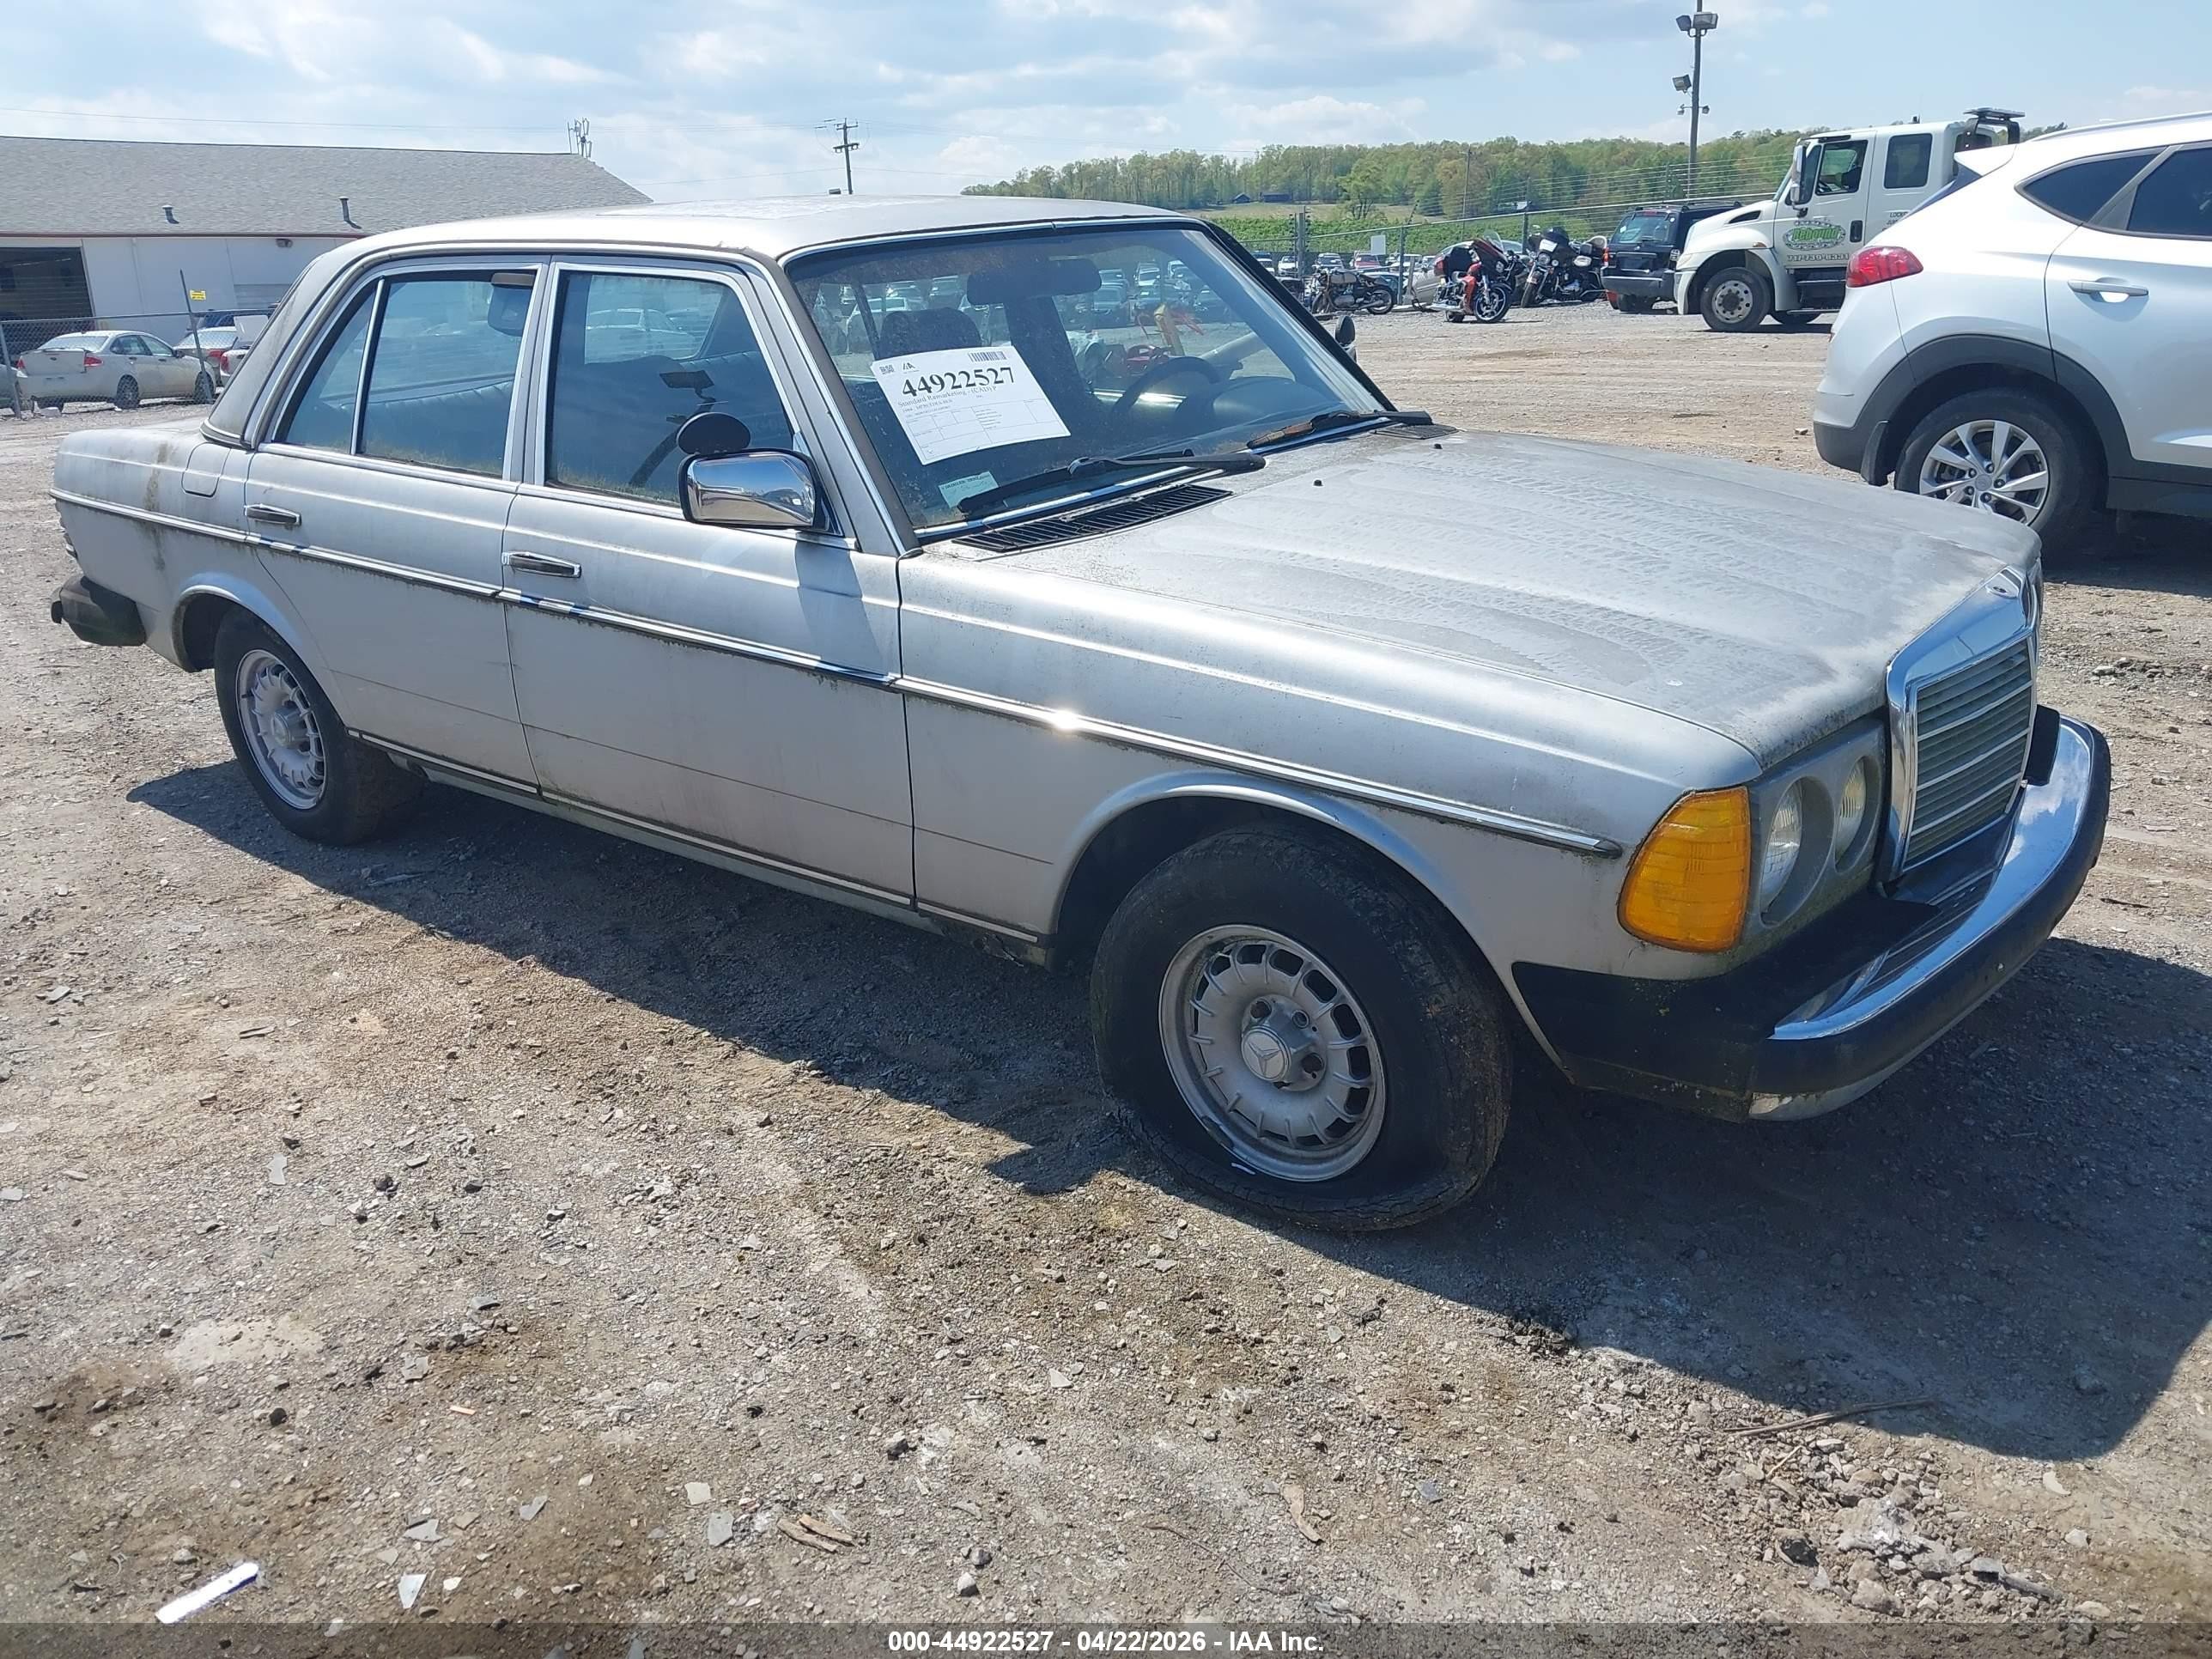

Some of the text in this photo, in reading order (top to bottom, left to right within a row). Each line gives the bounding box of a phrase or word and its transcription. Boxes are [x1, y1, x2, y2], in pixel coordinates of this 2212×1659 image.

[902, 367, 1015, 398] 44922527
[898, 395, 927, 407] Standard
[927, 389, 967, 403] Remarketing
